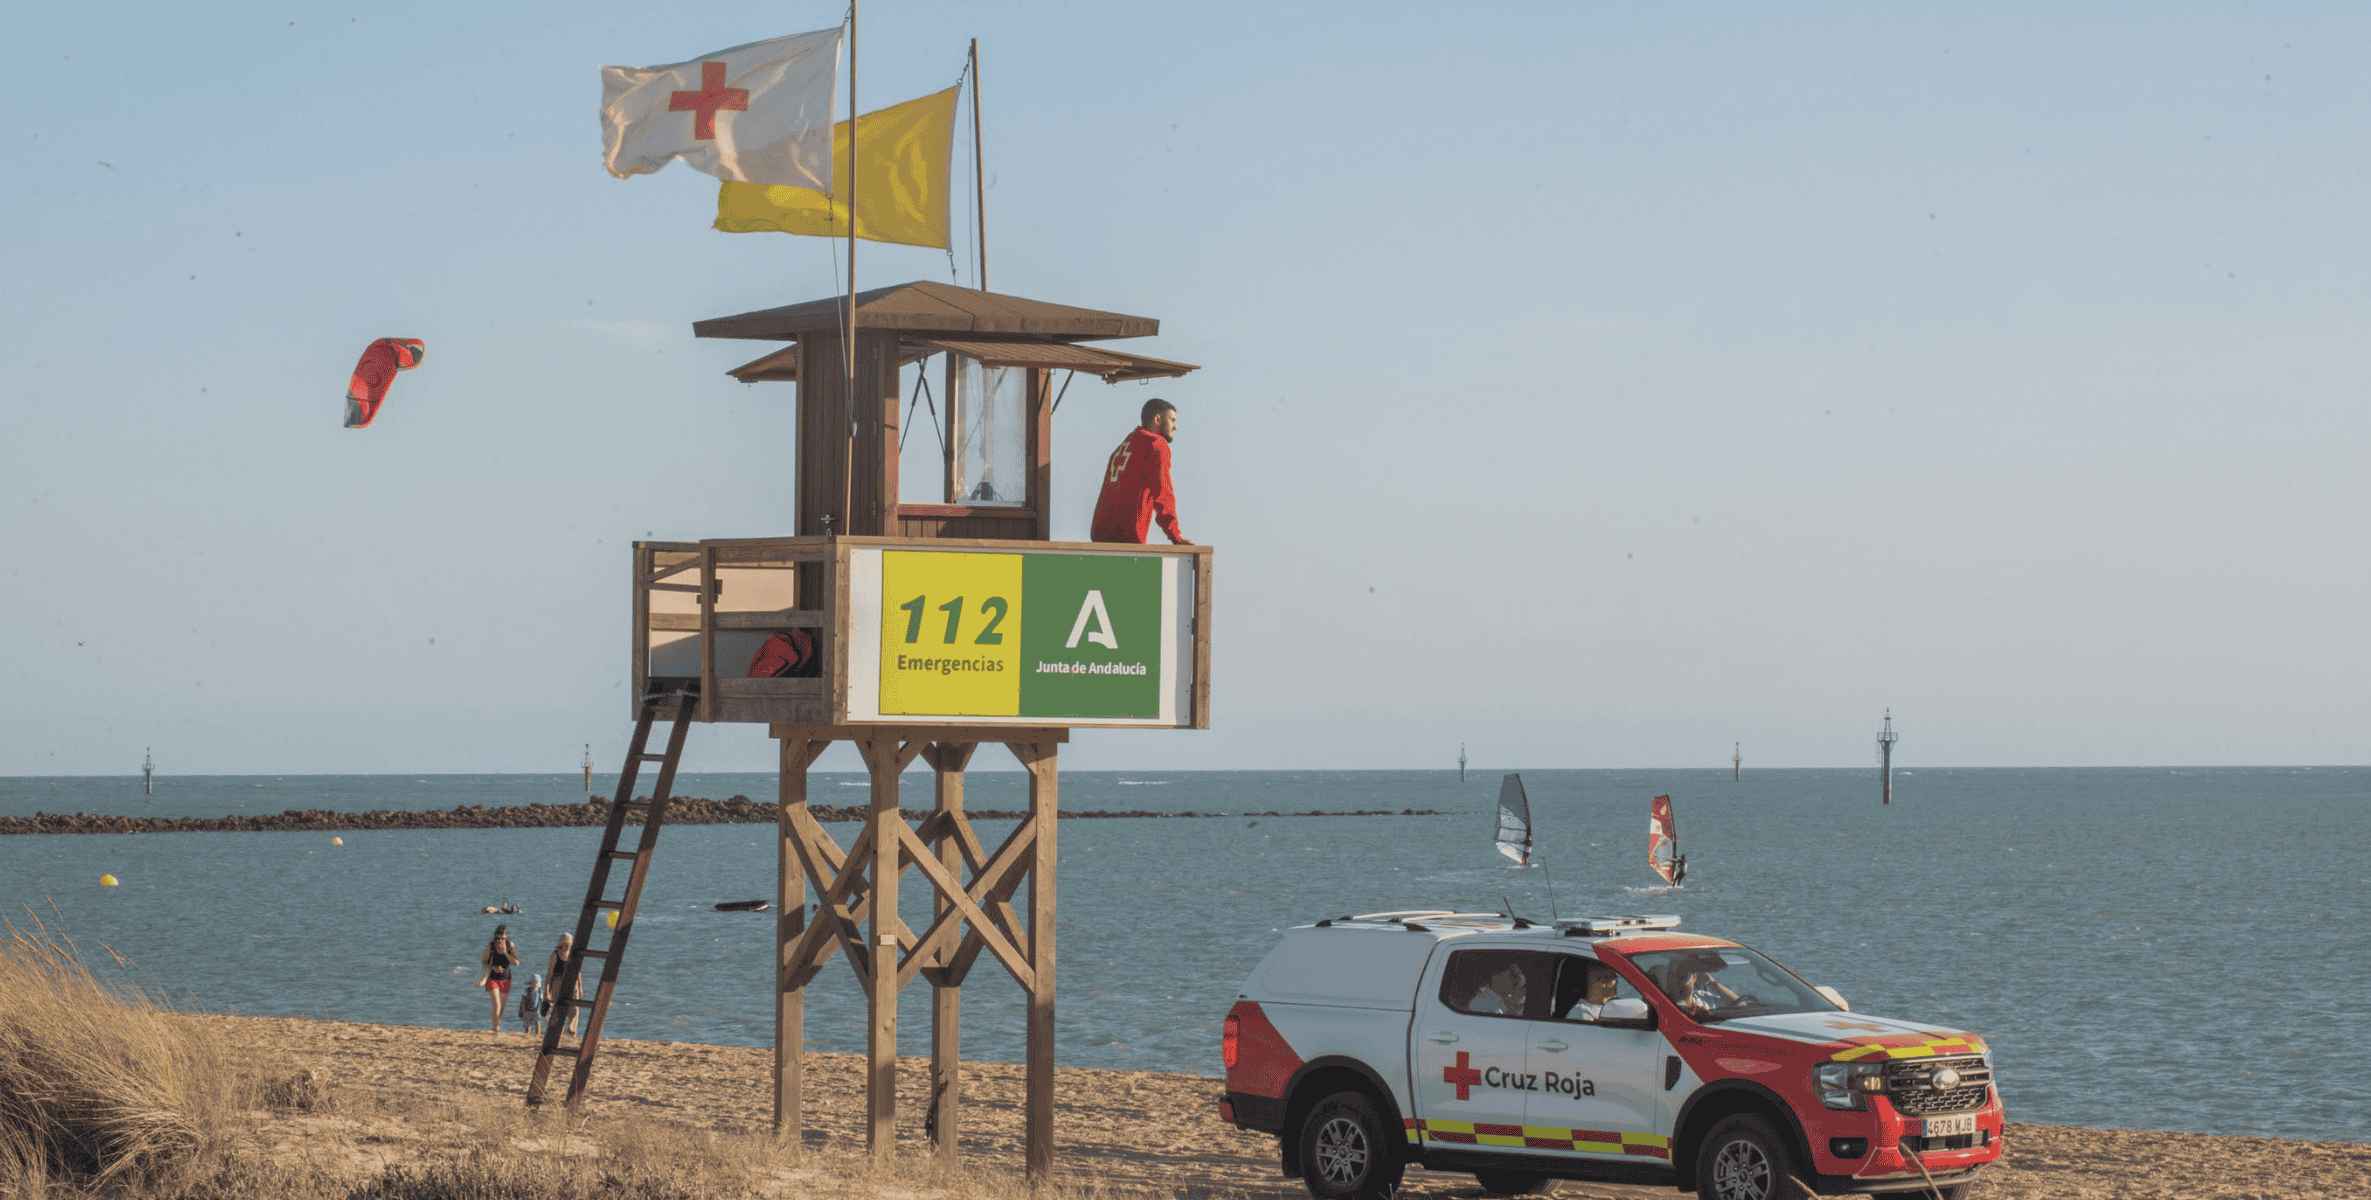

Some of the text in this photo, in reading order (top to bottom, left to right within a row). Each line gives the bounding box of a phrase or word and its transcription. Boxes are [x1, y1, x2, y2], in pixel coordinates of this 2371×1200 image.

[901, 595, 1008, 645] 112
[897, 655, 1004, 675] Emergencias
[1036, 661, 1147, 675] Junta de Andalucía
[1485, 1066, 1595, 1100] Cruz Roja
